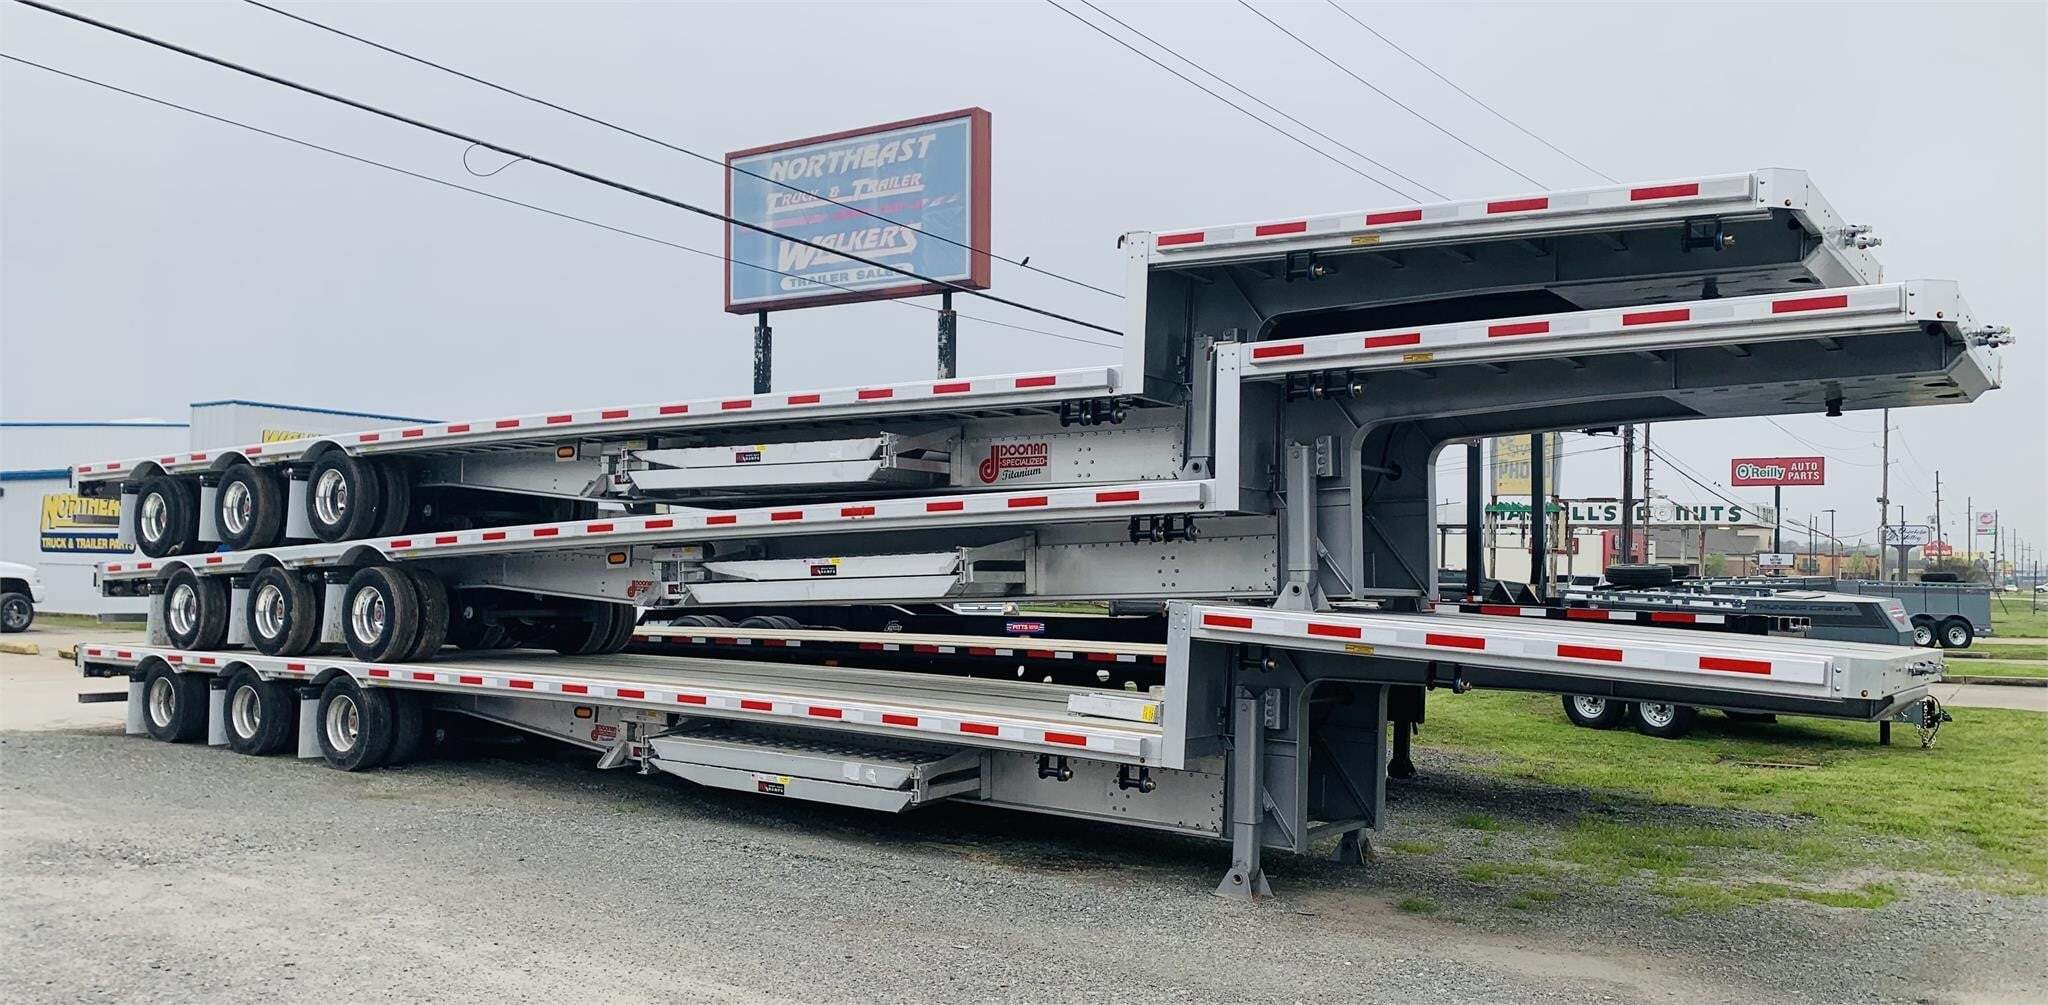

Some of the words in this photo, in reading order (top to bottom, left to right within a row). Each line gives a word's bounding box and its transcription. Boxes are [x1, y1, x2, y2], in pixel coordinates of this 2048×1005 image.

[768, 133, 936, 181] NORTHEAST
[766, 187, 819, 214] TRUCK
[828, 185, 840, 198] &
[852, 172, 923, 201] TRAILER
[789, 272, 849, 288] TRAILER
[1001, 443, 1048, 456] DOONAN
[1001, 457, 1045, 466] SPECIALIZED
[1791, 462, 1817, 471] AUTO
[1002, 468, 1041, 480] Titanium
[1737, 464, 1785, 480] O'Reilly
[1788, 471, 1819, 480] PARTS
[42, 537, 66, 549] TRUCK
[68, 537, 75, 549] &
[76, 538, 108, 550] TRAILER
